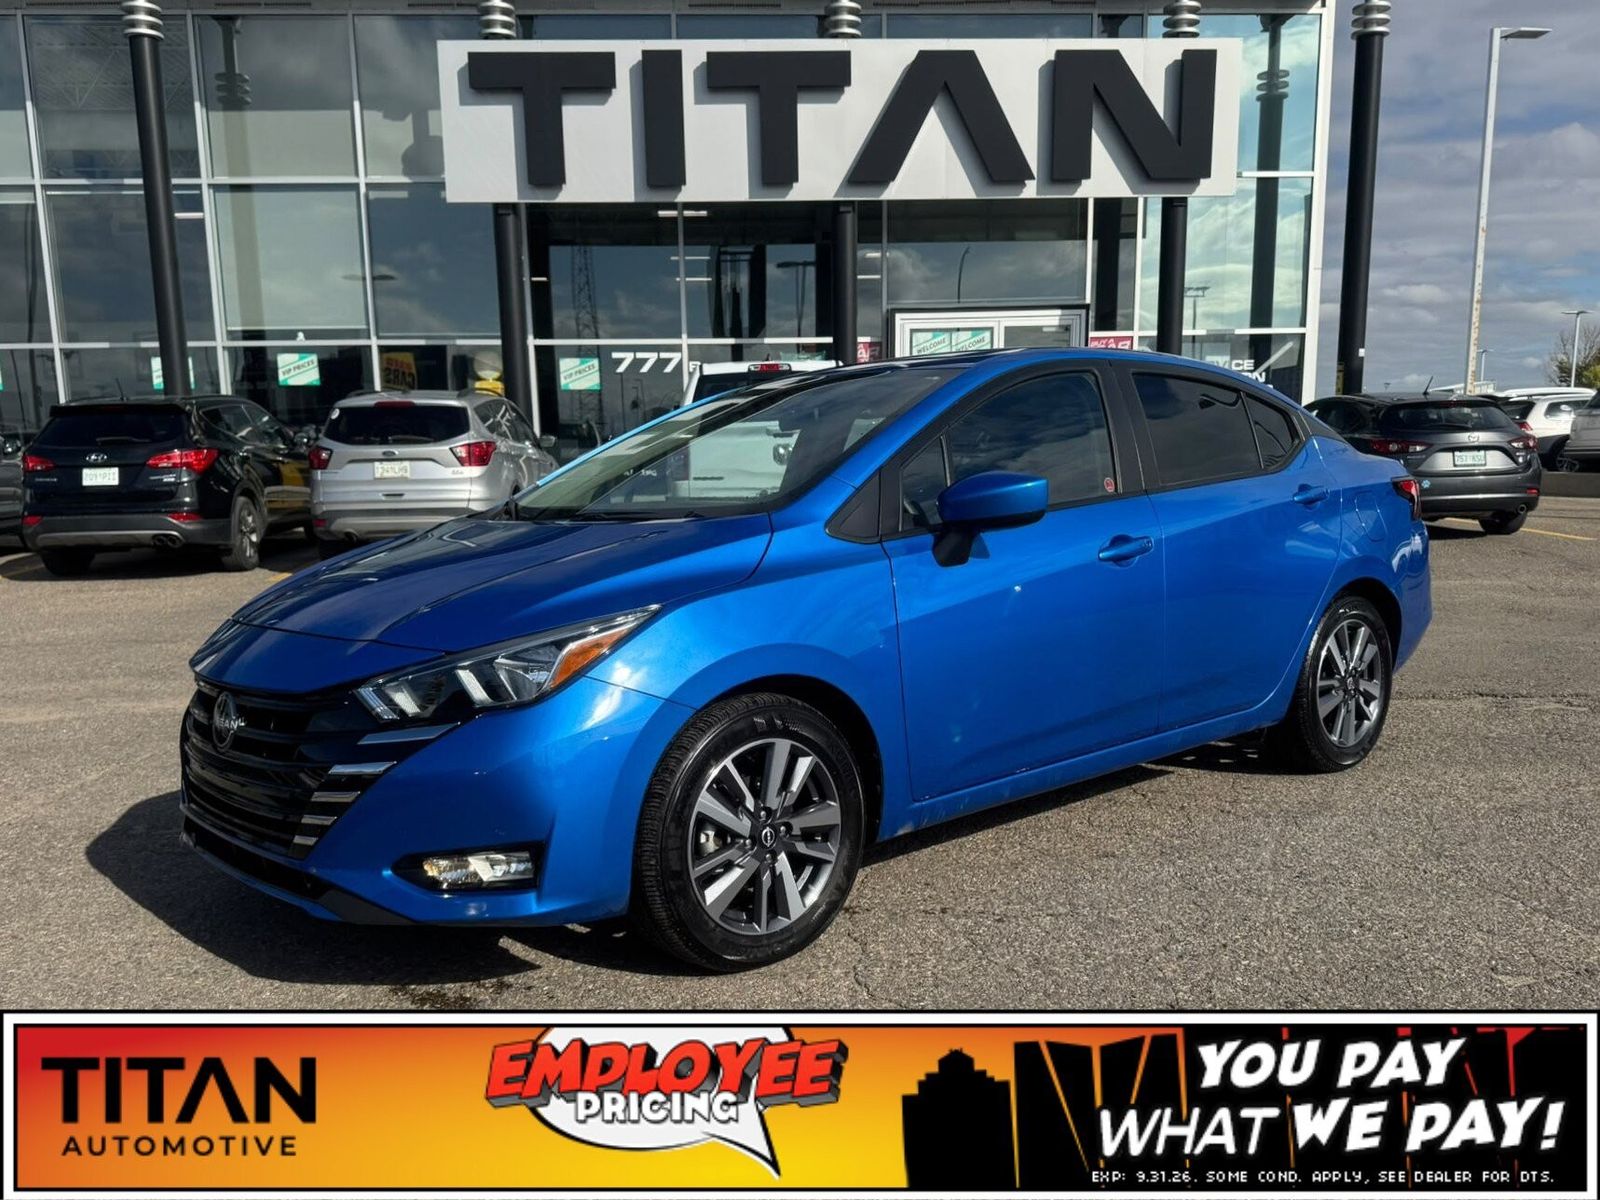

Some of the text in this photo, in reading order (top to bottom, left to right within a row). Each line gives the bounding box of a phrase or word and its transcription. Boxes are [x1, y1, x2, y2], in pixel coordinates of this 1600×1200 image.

[468, 49, 1218, 188] TITAN
[917, 338, 946, 354] WELCOME
[611, 351, 682, 374] 777
